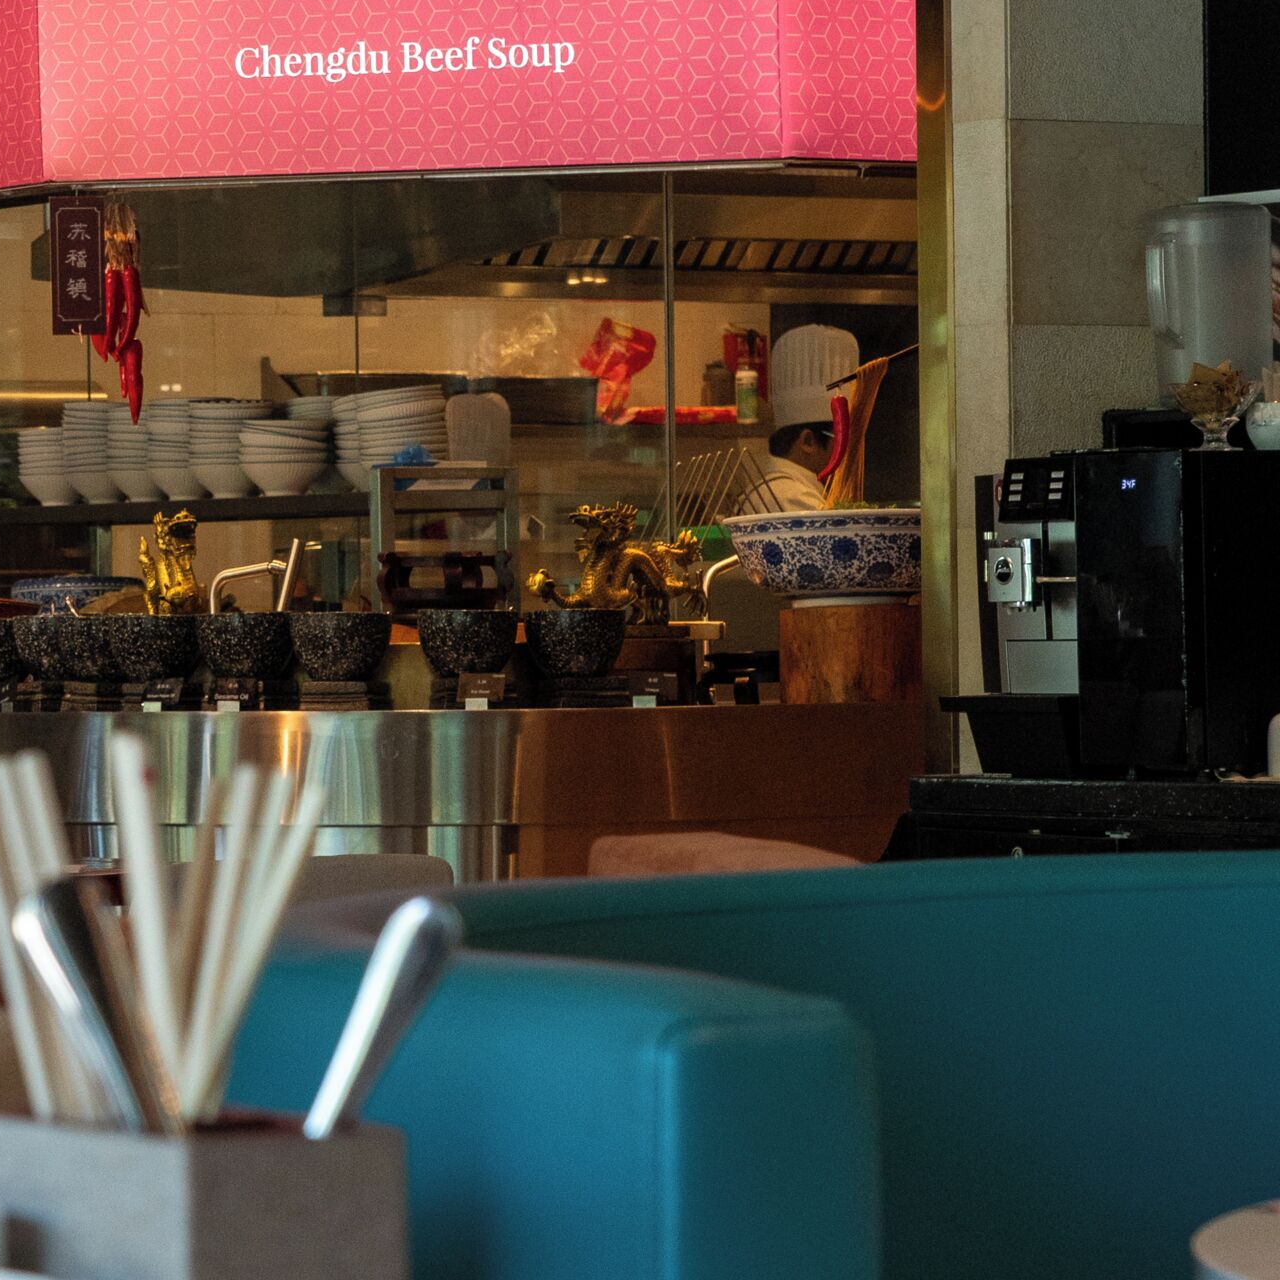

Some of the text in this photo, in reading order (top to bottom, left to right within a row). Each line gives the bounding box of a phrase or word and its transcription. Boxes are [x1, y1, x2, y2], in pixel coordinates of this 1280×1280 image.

[234, 36, 576, 83] Chengdu Beef Soup
